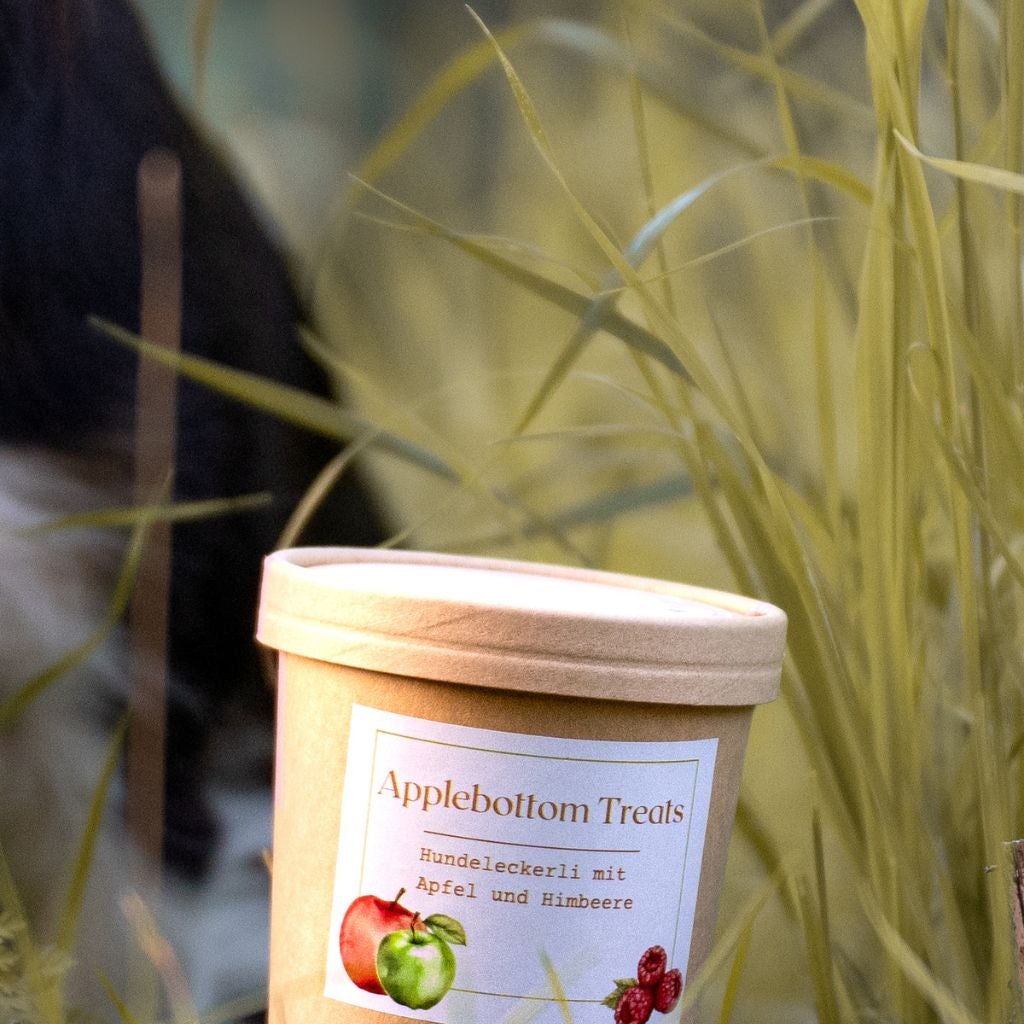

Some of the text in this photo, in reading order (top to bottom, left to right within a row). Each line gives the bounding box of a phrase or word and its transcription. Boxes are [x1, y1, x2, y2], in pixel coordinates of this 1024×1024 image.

[377, 770, 685, 825] Applebottom Treats
[420, 847, 626, 881] Hundeleckerli mit
[416, 876, 633, 910] Apfel und Himbeere
